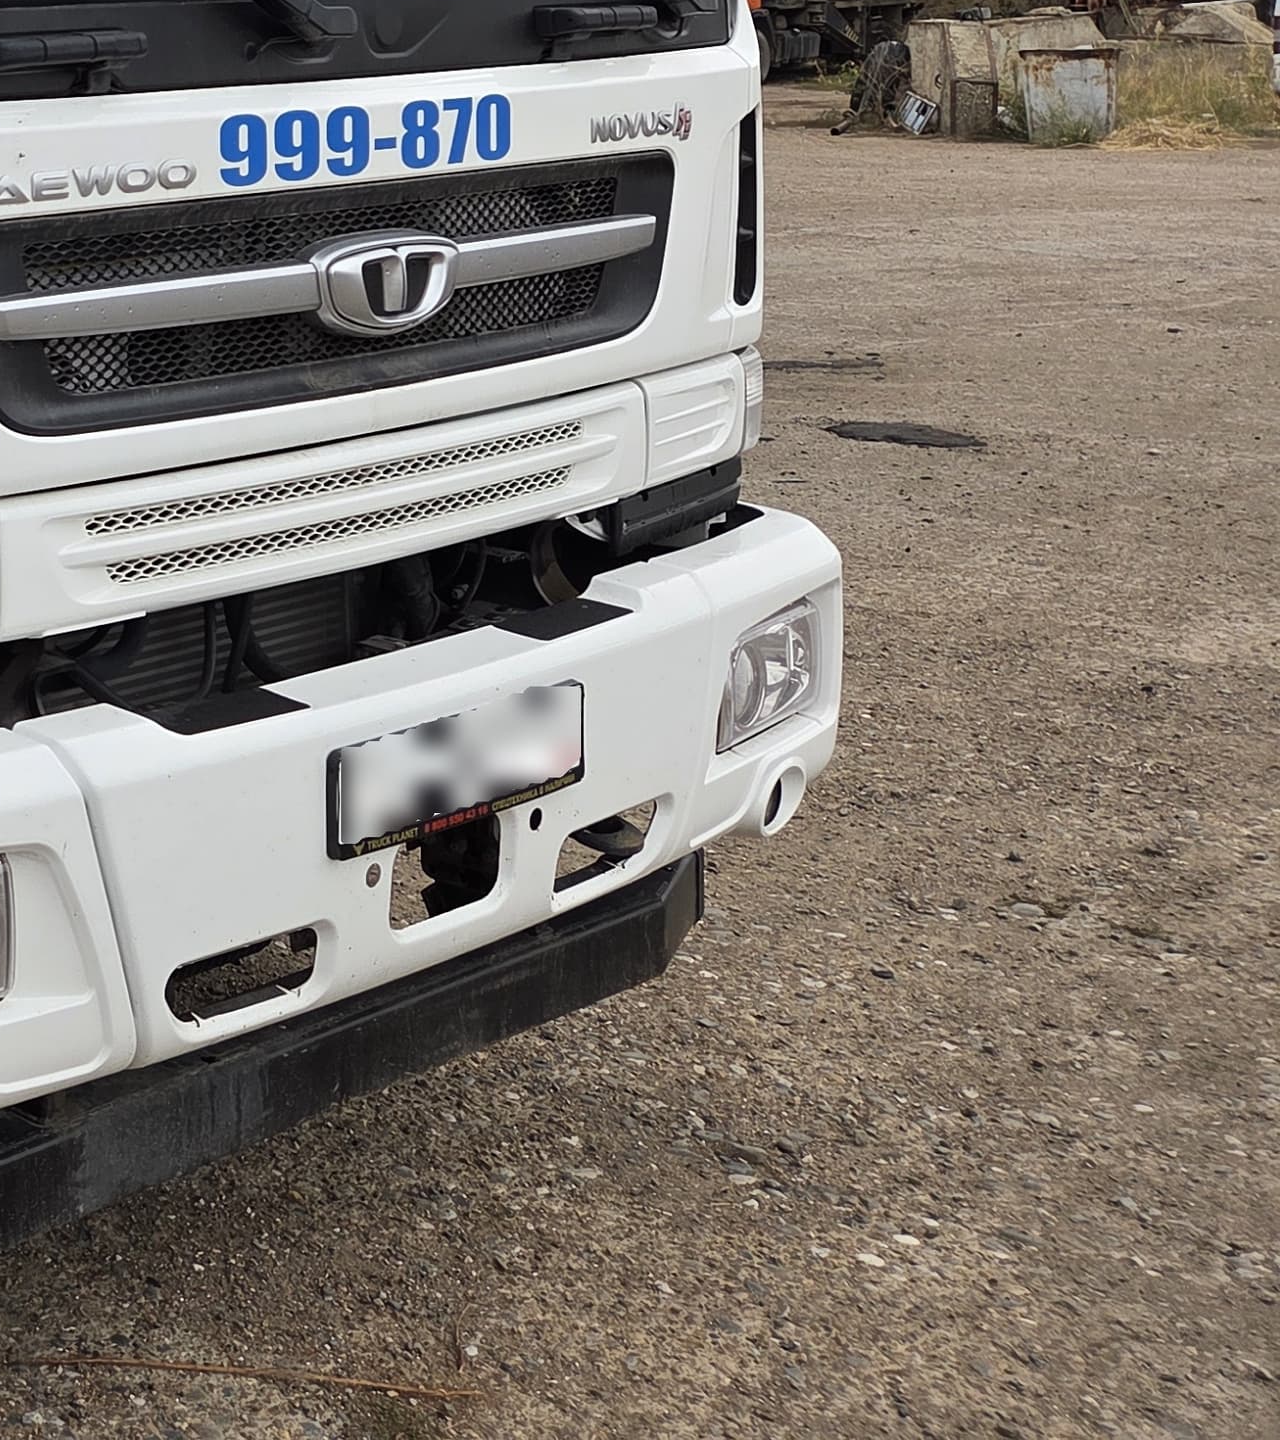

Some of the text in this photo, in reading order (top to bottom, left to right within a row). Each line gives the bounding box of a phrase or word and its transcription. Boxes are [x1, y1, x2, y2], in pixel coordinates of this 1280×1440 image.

[219, 94, 512, 187] 999-870
[590, 111, 674, 143] NOVUS
[367, 826, 419, 851] TRUCK PLANET
